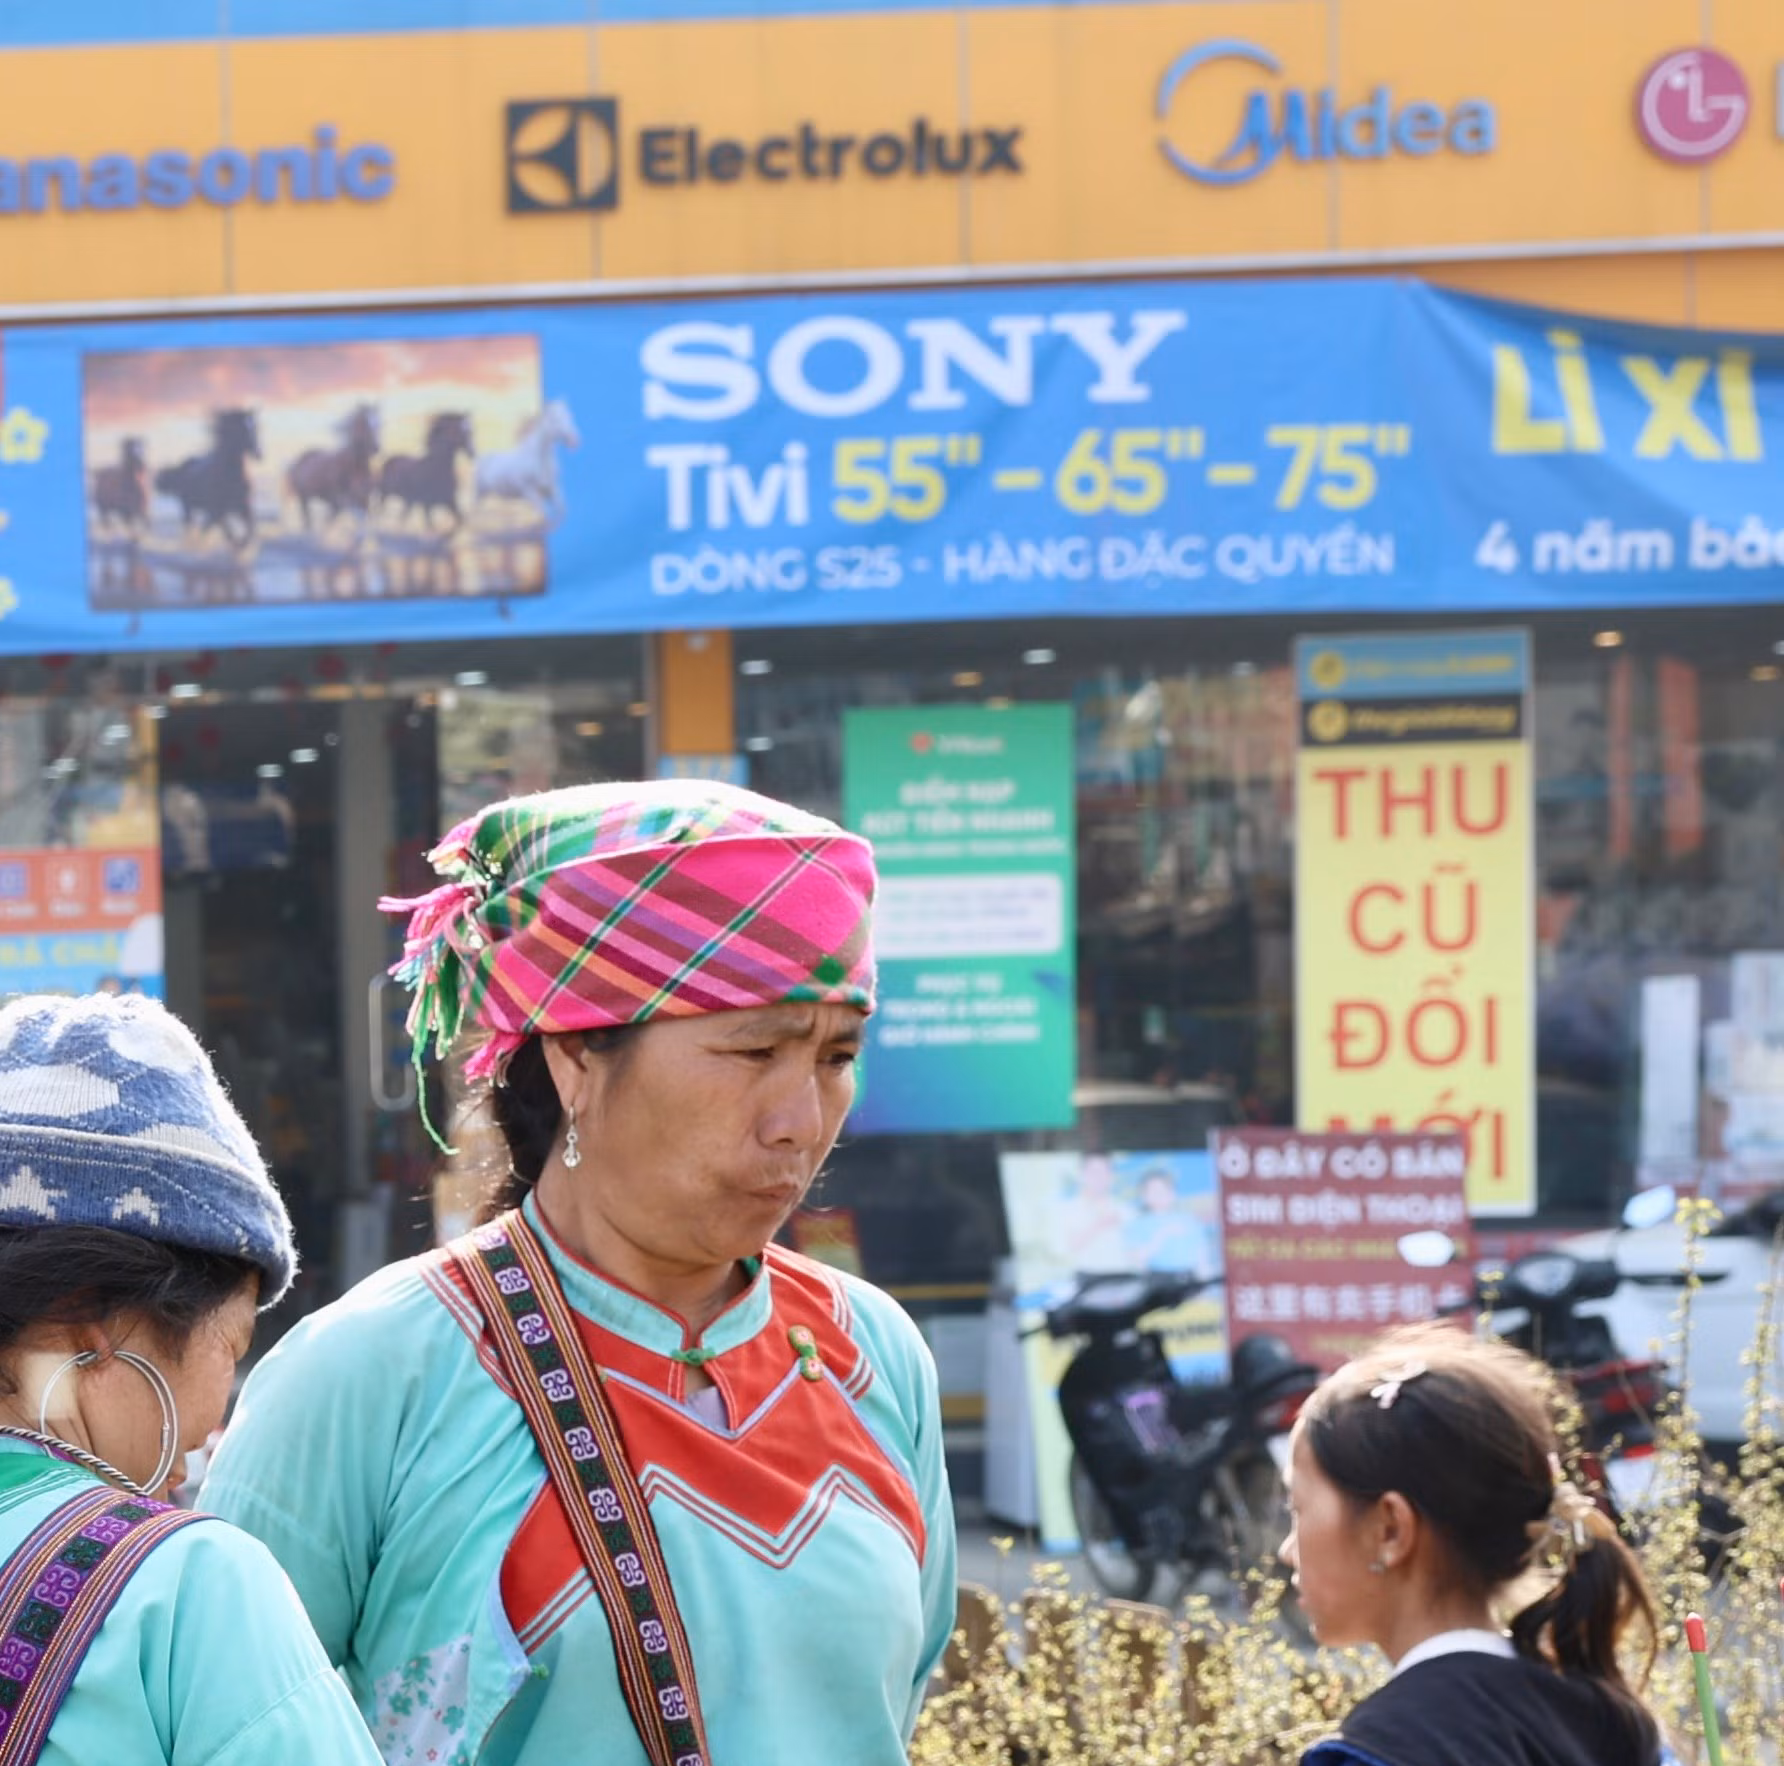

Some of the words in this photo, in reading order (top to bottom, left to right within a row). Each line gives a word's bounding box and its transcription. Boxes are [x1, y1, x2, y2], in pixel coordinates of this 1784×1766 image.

[637, 115, 1026, 188] Electrolux
[1225, 88, 1500, 168] Midea
[640, 309, 1188, 422] SONY
[650, 542, 807, 596] DÒNG
[815, 545, 902, 590] S25
[943, 534, 1090, 584] HÀNG
[1475, 518, 1522, 574] 4
[1533, 517, 1675, 574] năm
[1689, 512, 1784, 571] bả
[1313, 762, 1511, 840] THU
[1347, 861, 1479, 955] CŨ
[1325, 962, 1499, 1071] ĐỔI
